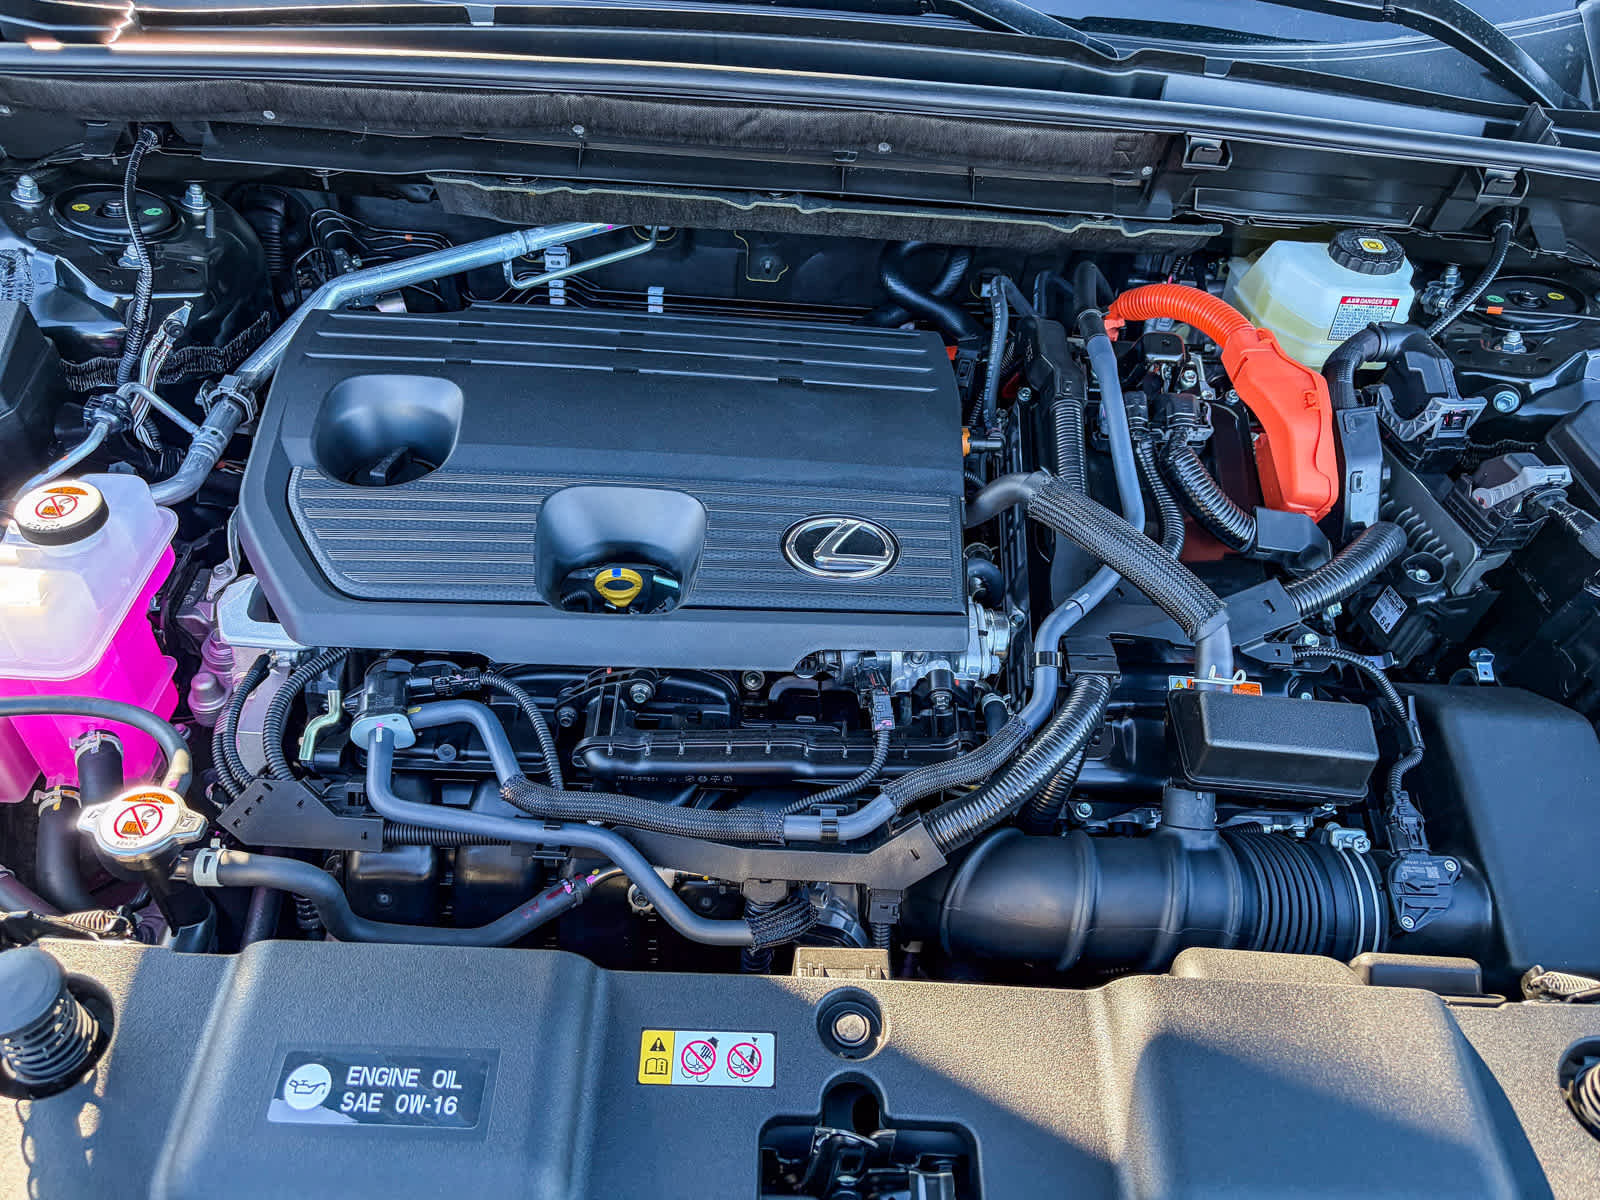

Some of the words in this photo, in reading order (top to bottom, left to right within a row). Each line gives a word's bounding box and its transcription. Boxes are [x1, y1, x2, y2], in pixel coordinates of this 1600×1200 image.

[345, 1066, 421, 1088] ENGINE
[432, 1069, 462, 1089] OIL
[340, 1092, 383, 1113] SAE
[395, 1093, 459, 1115] 0W-16
